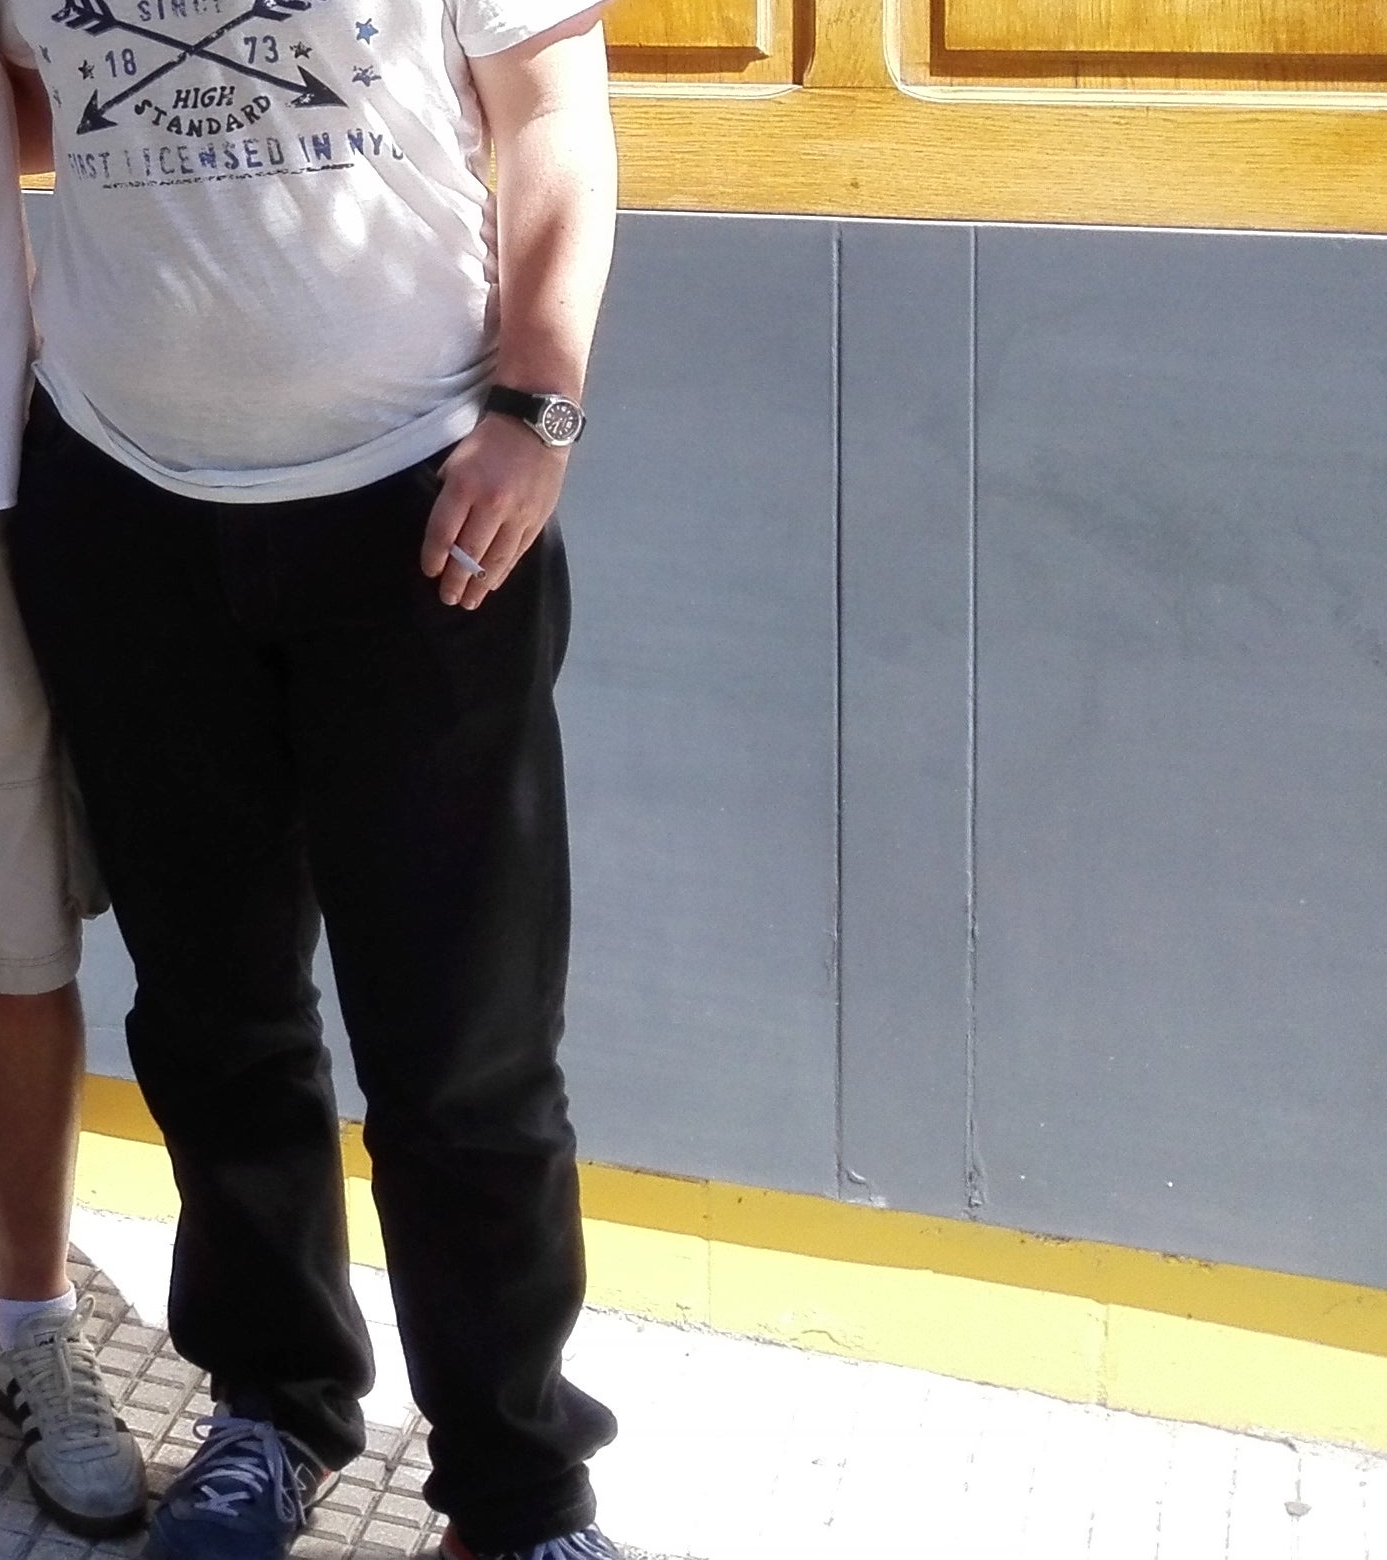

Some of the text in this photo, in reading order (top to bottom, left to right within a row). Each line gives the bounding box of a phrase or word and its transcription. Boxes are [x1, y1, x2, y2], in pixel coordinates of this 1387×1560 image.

[105, 35, 279, 78] 18 73
[134, 95, 272, 138] STANDARD
[172, 86, 235, 110] HIGH
[299, 132, 332, 163] IN
